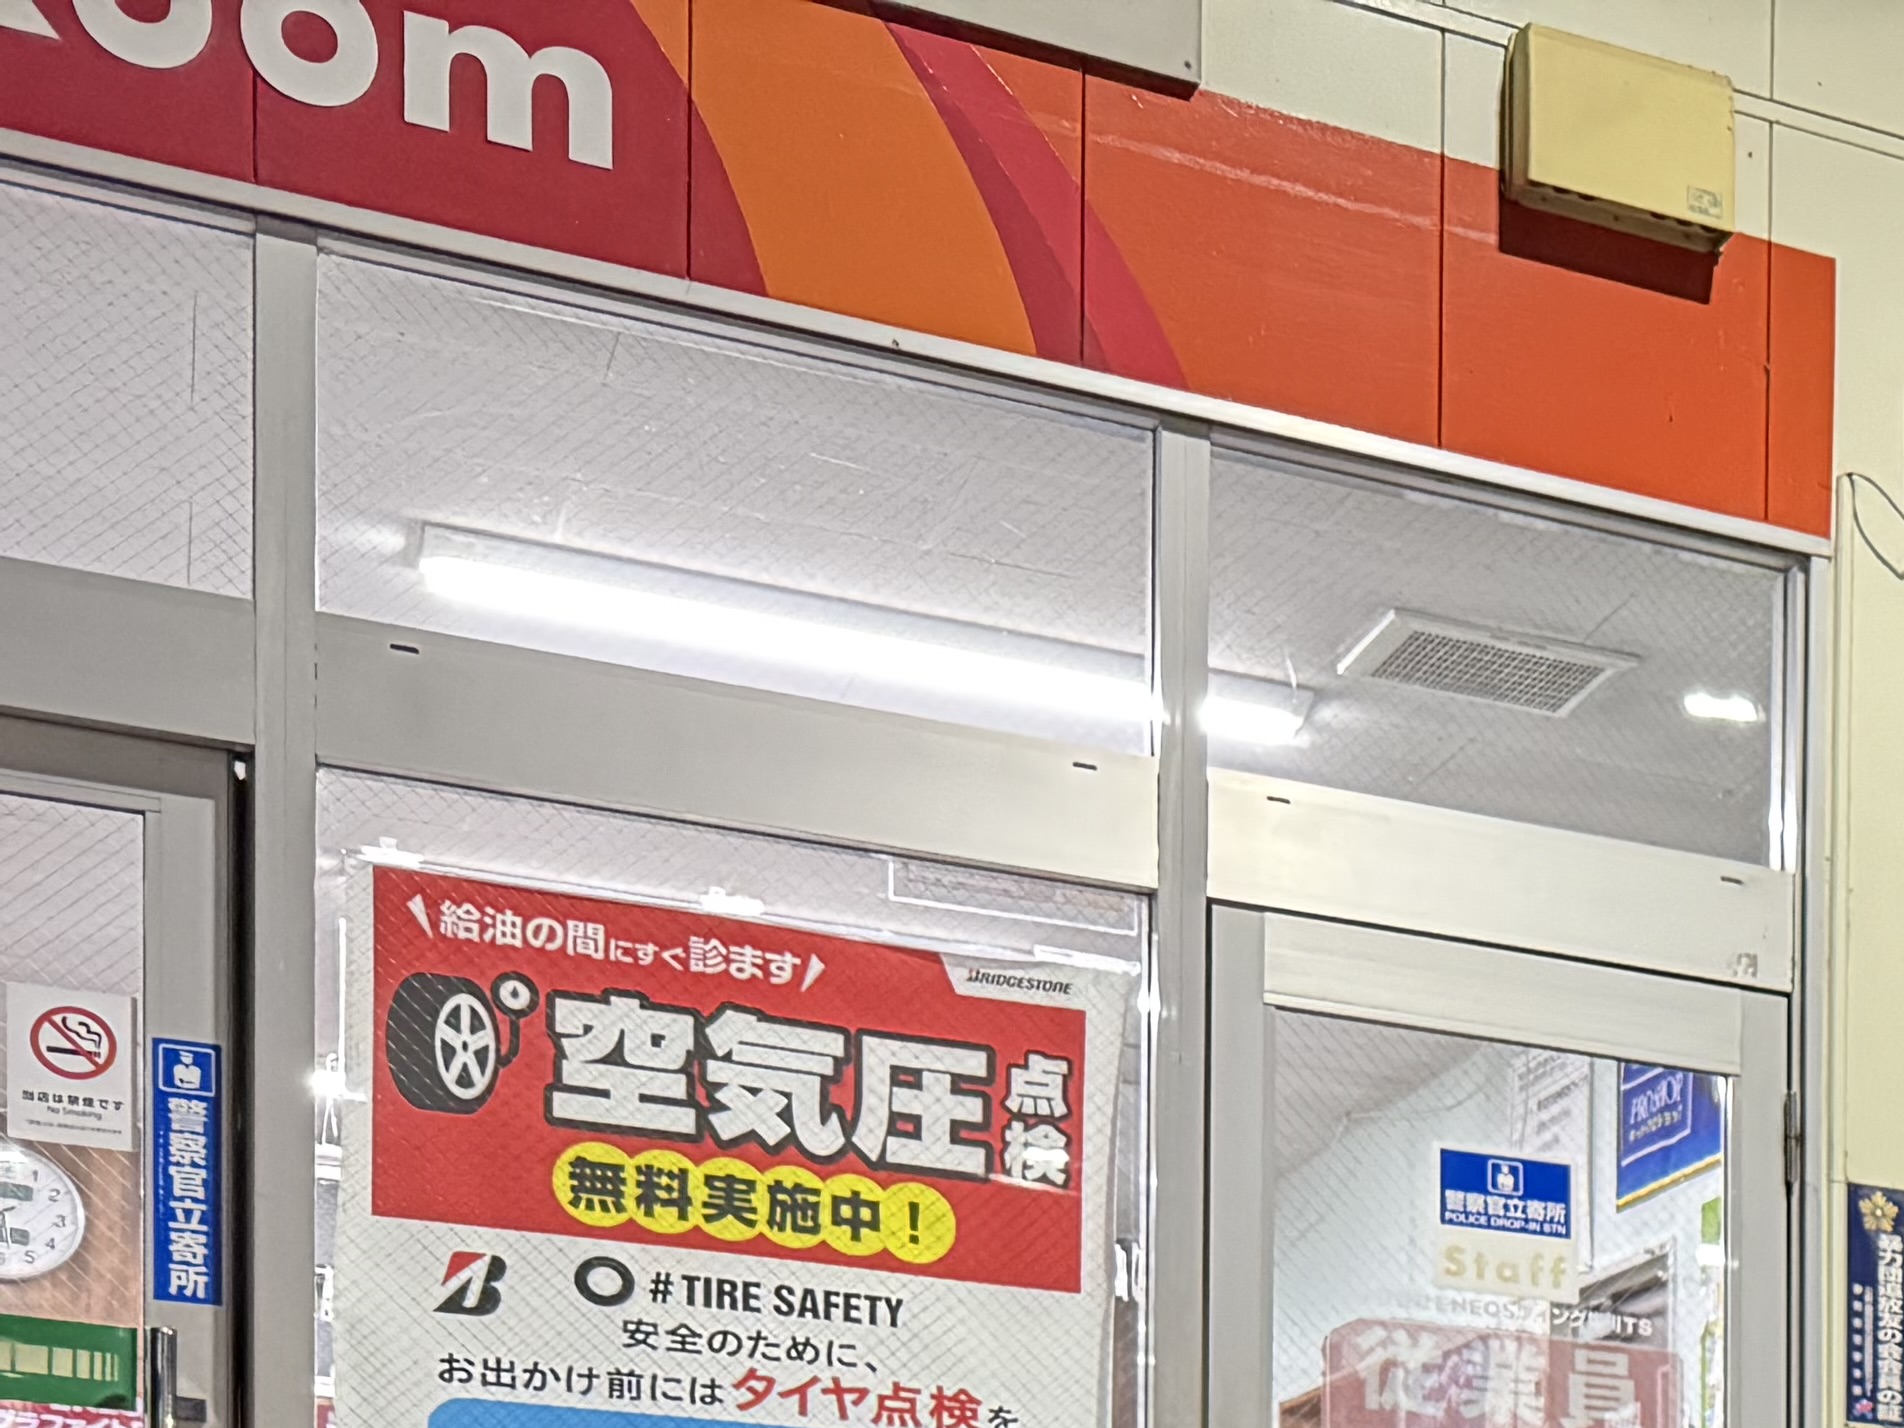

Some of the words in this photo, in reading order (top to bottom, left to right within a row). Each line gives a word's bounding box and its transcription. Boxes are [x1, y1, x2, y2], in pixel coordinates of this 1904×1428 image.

[0, 0, 613, 170] oom
[440, 899, 801, 984] 給油の間にすぐ診ます
[967, 967, 1073, 995] BRIDGESTONE
[548, 996, 992, 1178] 空気圧
[168, 1097, 209, 1301] 警察官立寄所
[567, 1156, 923, 1246] 無料実施中！
[1444, 1188, 1567, 1224] 警察官立寄所
[1445, 1210, 1488, 1226] POLICE
[1442, 1244, 1567, 1290] Staff
[773, 1286, 904, 1329] SAFETY
[621, 1317, 879, 1374] 安全のために、
